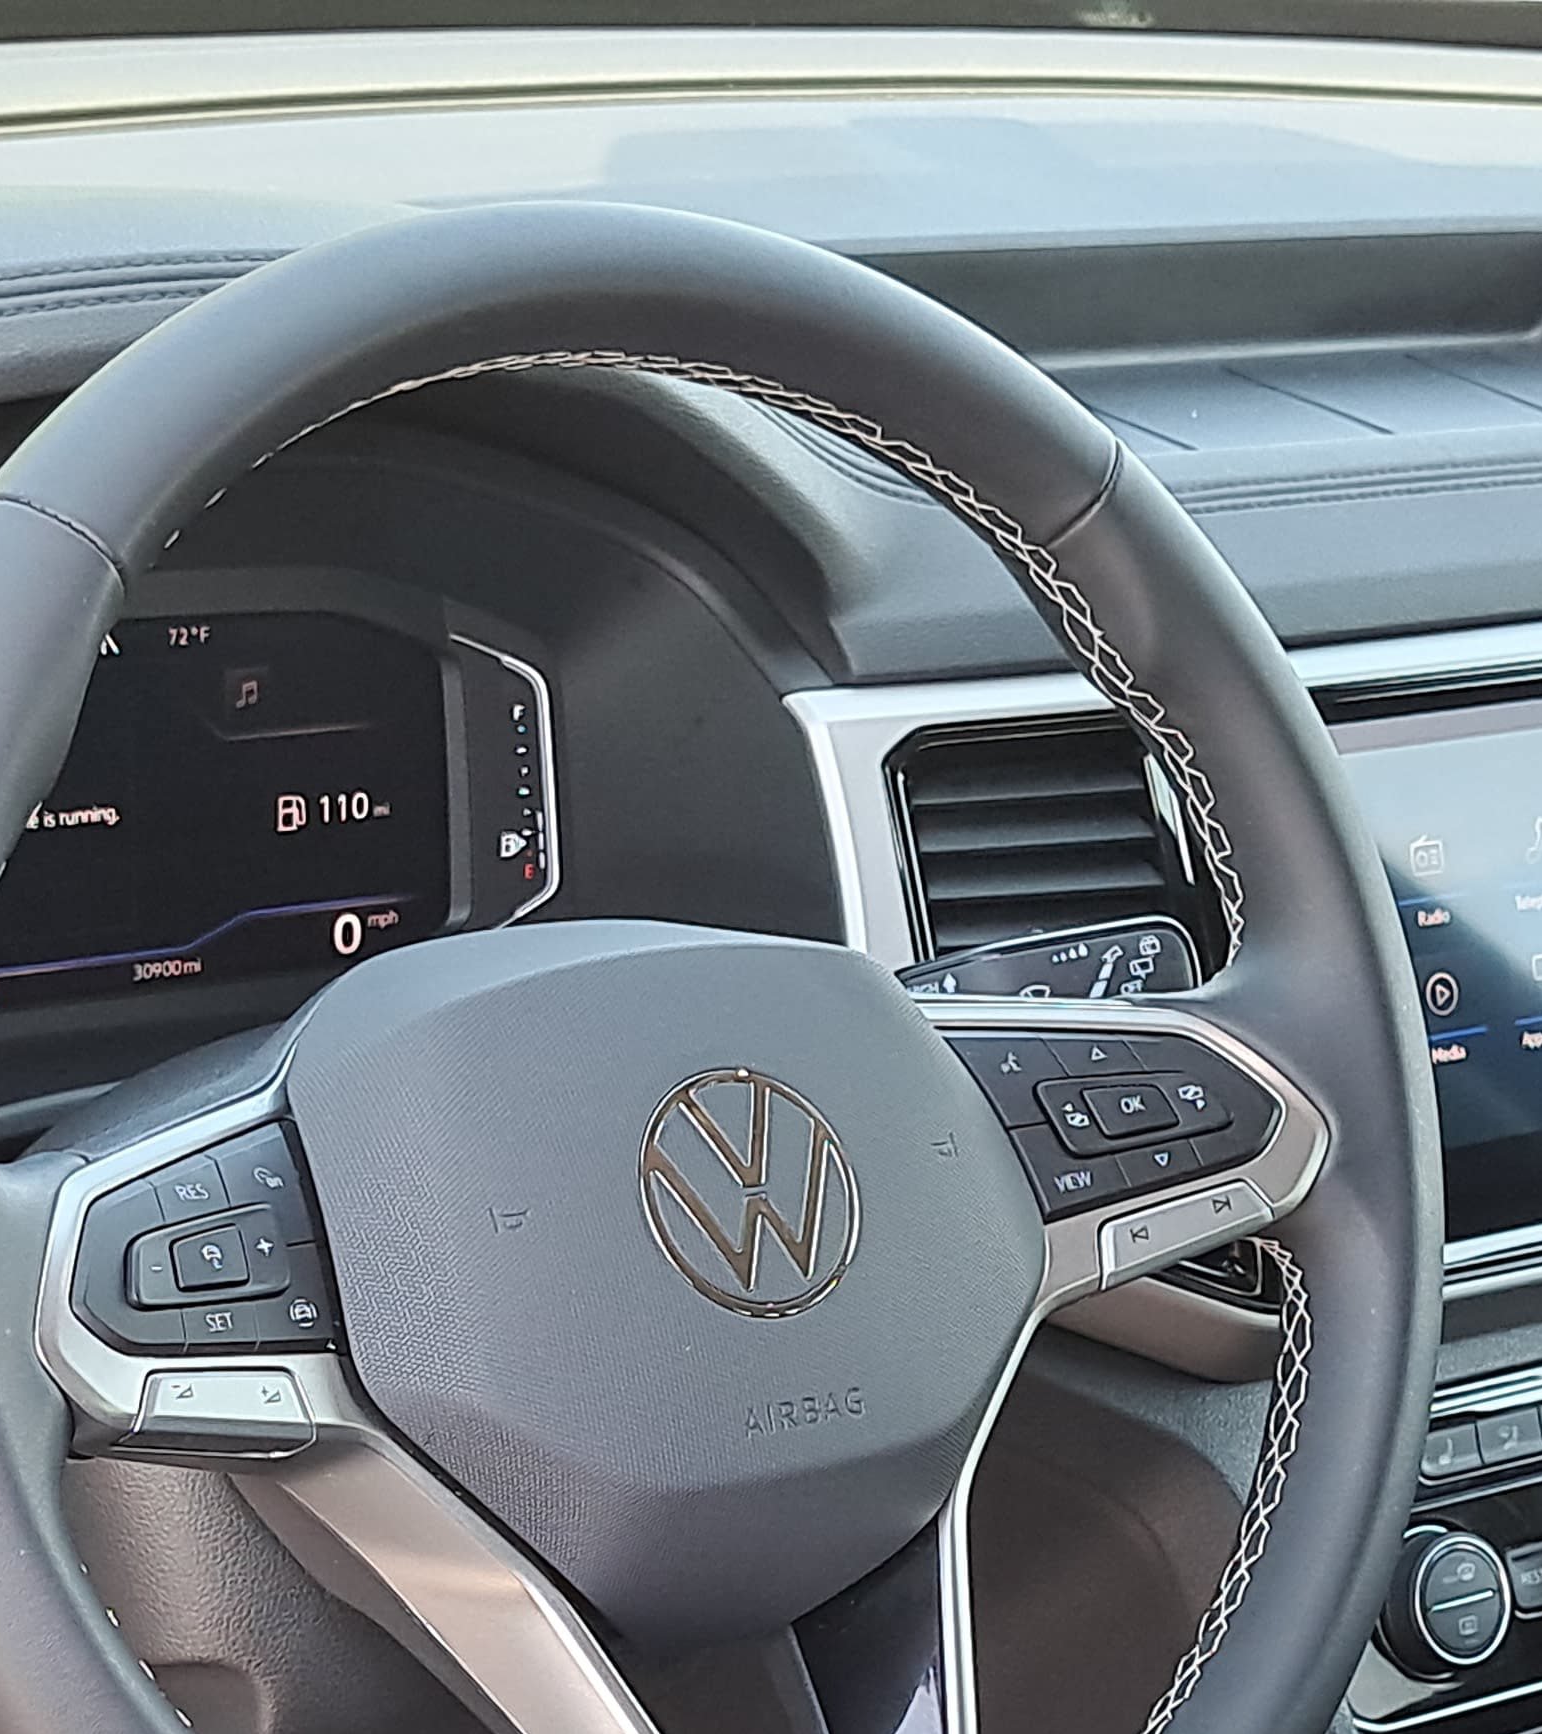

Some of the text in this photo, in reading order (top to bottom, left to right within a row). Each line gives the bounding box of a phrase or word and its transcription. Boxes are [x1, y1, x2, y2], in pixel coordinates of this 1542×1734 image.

[169, 626, 211, 646] 72°F
[43, 811, 56, 828] is
[59, 806, 120, 825] running.
[318, 792, 369, 822] 110
[1417, 909, 1450, 927] Radio
[332, 910, 398, 955] 0 mph
[1432, 1045, 1467, 1064] Media
[1121, 1096, 1146, 1115] OK
[175, 1183, 209, 1201] RES
[1053, 1172, 1093, 1192] VIEW
[205, 1312, 234, 1332] SET
[744, 1388, 866, 1439] AIRBAG
